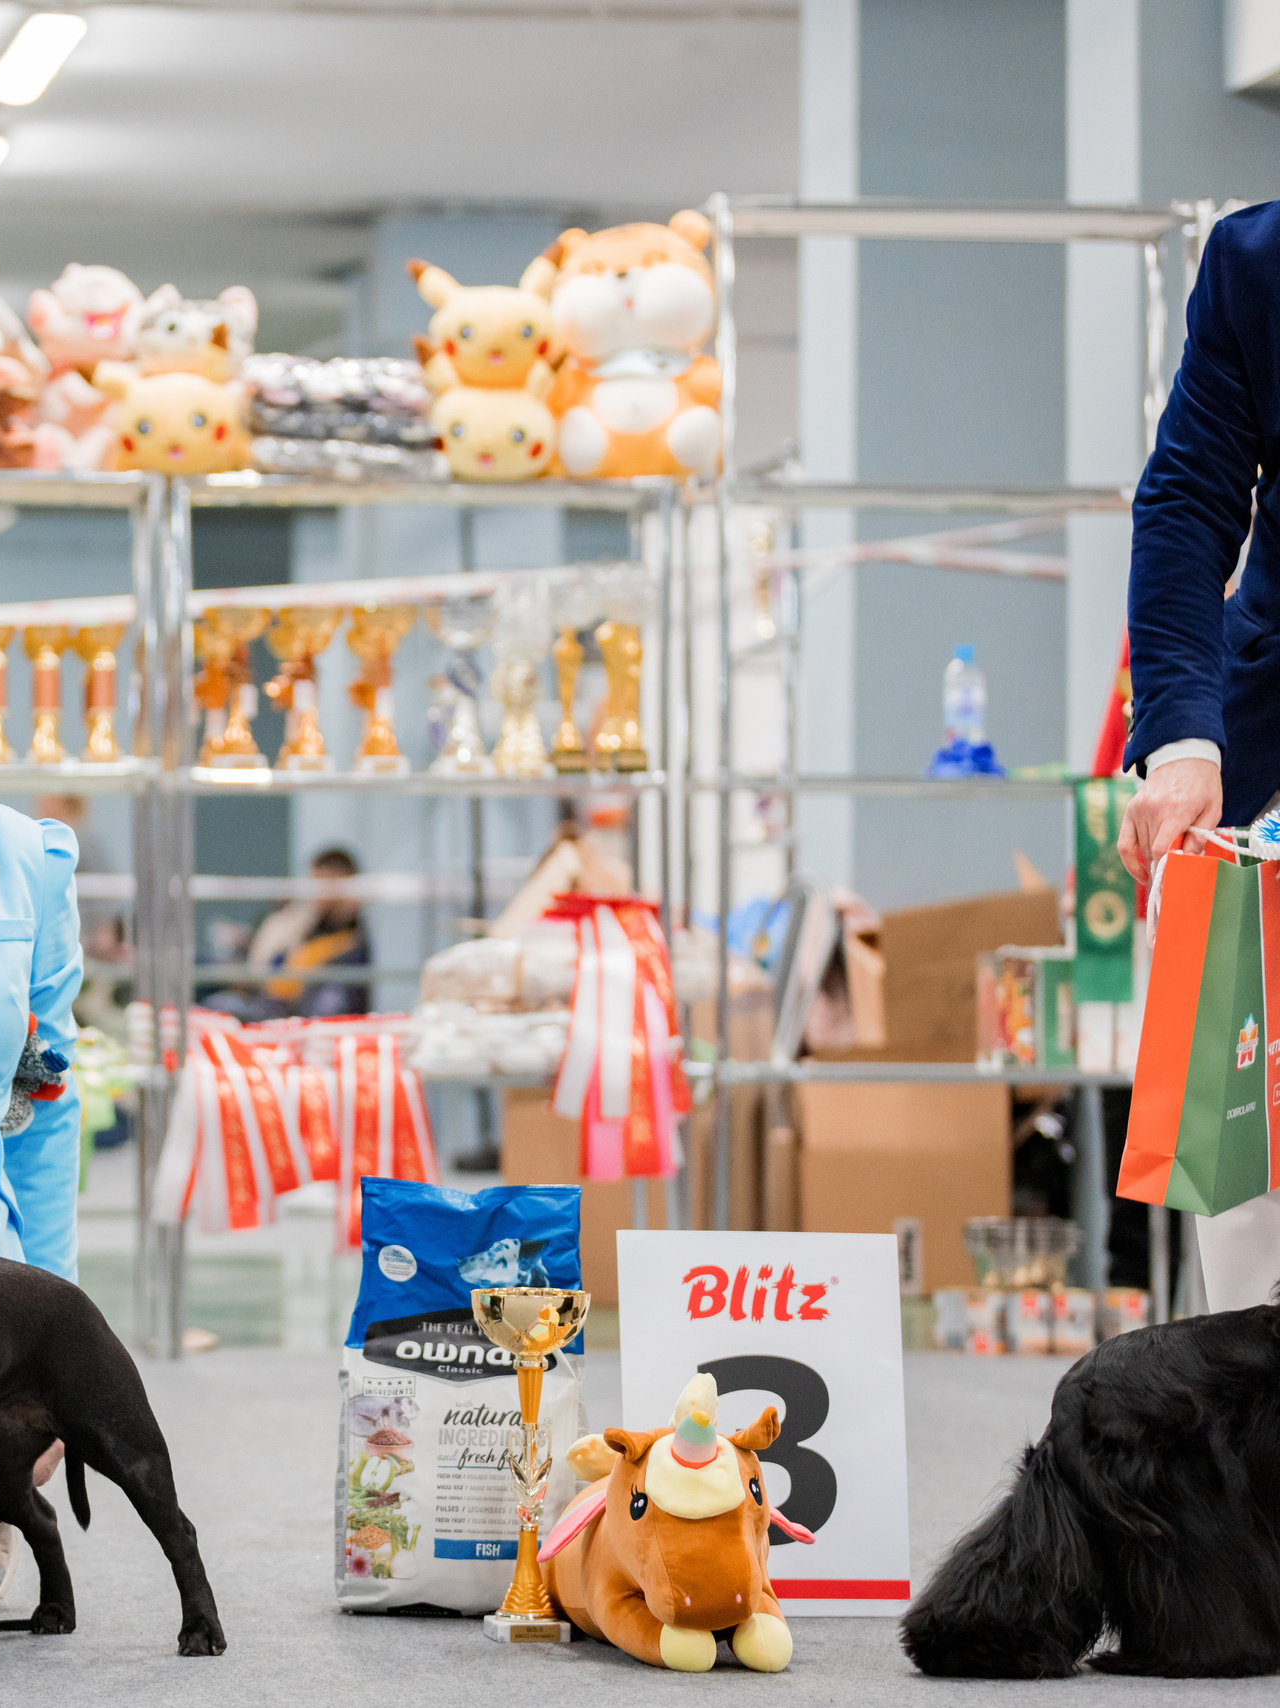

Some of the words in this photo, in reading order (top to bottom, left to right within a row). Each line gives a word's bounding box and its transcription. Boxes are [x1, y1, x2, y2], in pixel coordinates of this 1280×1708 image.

[682, 1263, 831, 1324] Blitz
[422, 1322, 443, 1333] THE
[447, 1323, 474, 1336] REAL
[396, 1341, 514, 1366] owna
[437, 1365, 484, 1374] Classic
[365, 1387, 414, 1396] INGREDIENTS
[443, 1403, 523, 1427] natura
[437, 1449, 459, 1461] and
[457, 1447, 497, 1470] fresh
[697, 1355, 838, 1546] 3
[468, 1506, 506, 1514] LEGUMBRES
[475, 1543, 501, 1557] FISH
